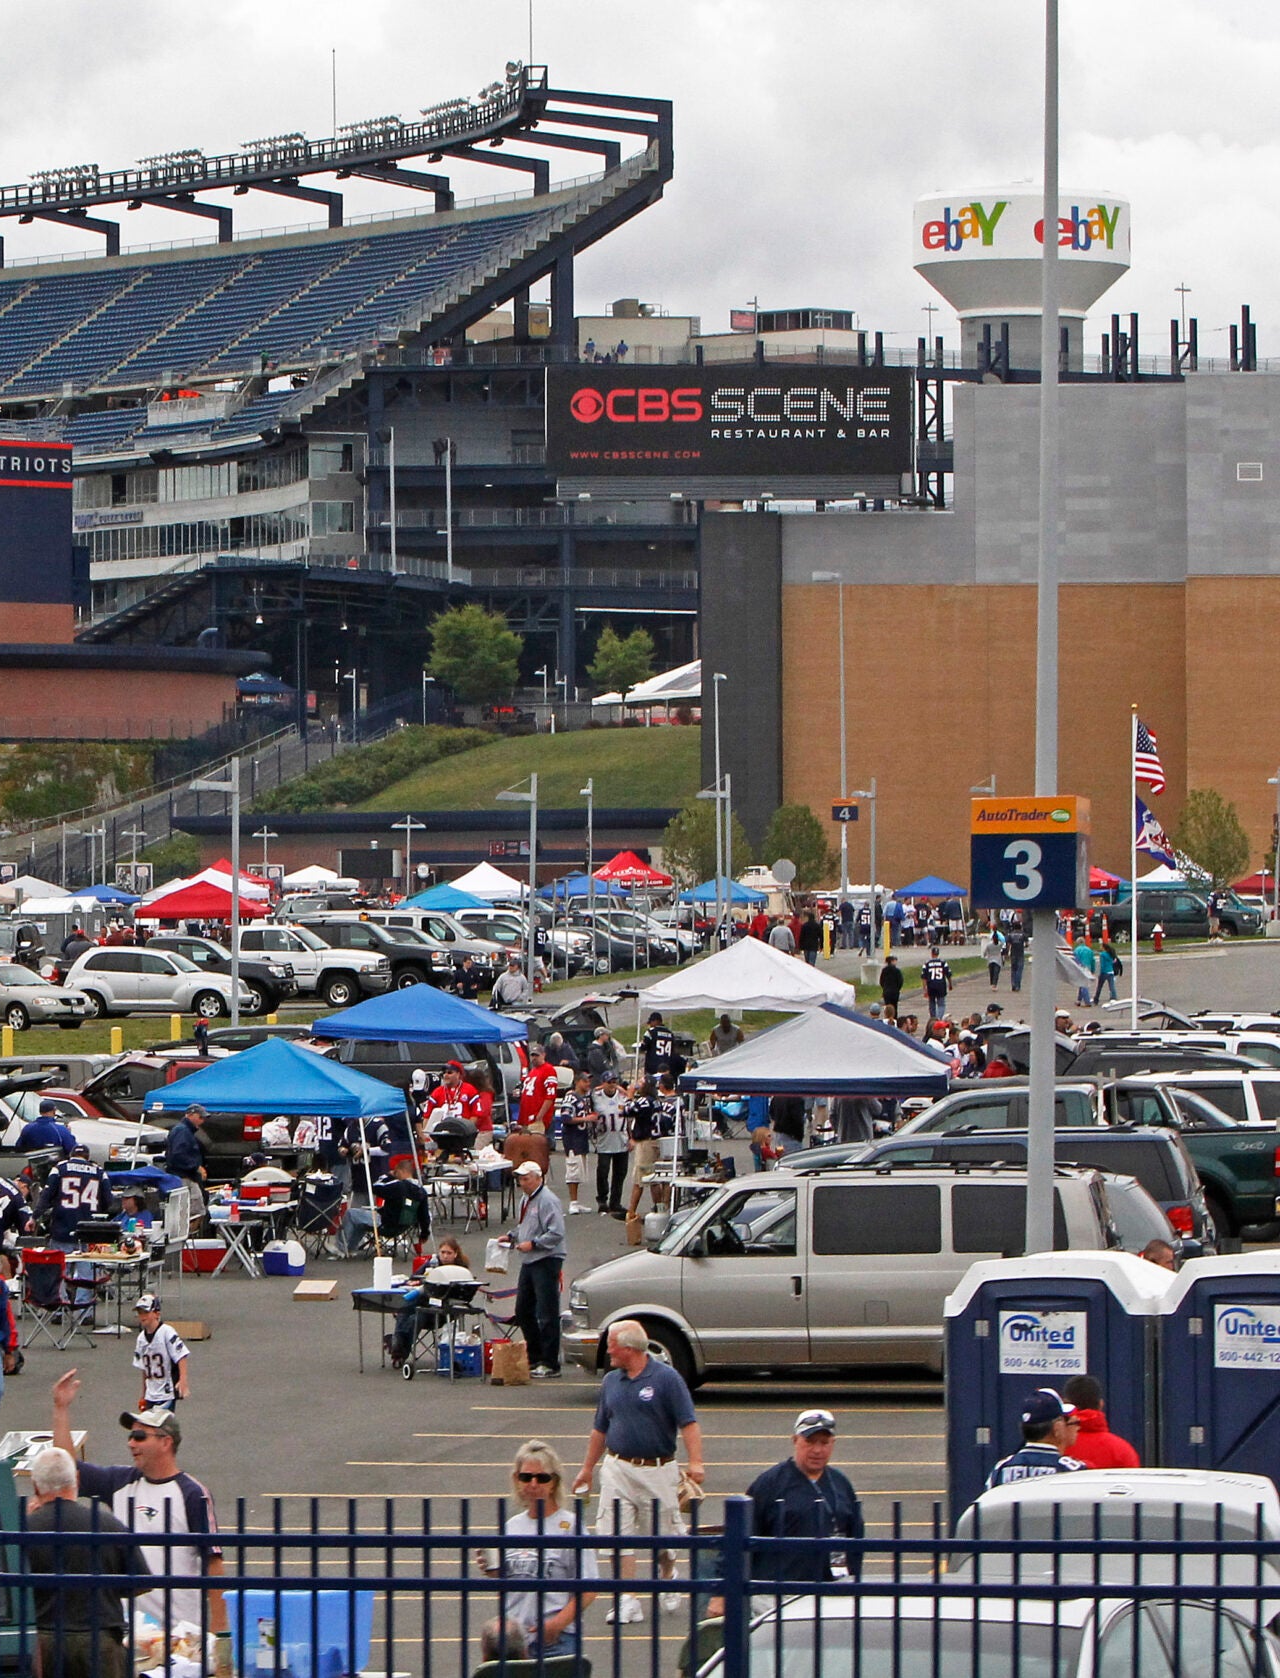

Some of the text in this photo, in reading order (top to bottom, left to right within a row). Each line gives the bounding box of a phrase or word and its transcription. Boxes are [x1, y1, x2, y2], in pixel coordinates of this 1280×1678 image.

[606, 387, 891, 423] CBS SCENE
[711, 428, 891, 439] RESTAURANT & BAR
[839, 807, 851, 820] 4
[1002, 839, 1043, 901] 3
[928, 968, 943, 980] 75
[655, 1040, 672, 1057] 54
[316, 1115, 333, 1140] 12
[60, 1177, 100, 1211] 54
[1010, 1322, 1075, 1343] United
[1225, 1317, 1280, 1337] Unite
